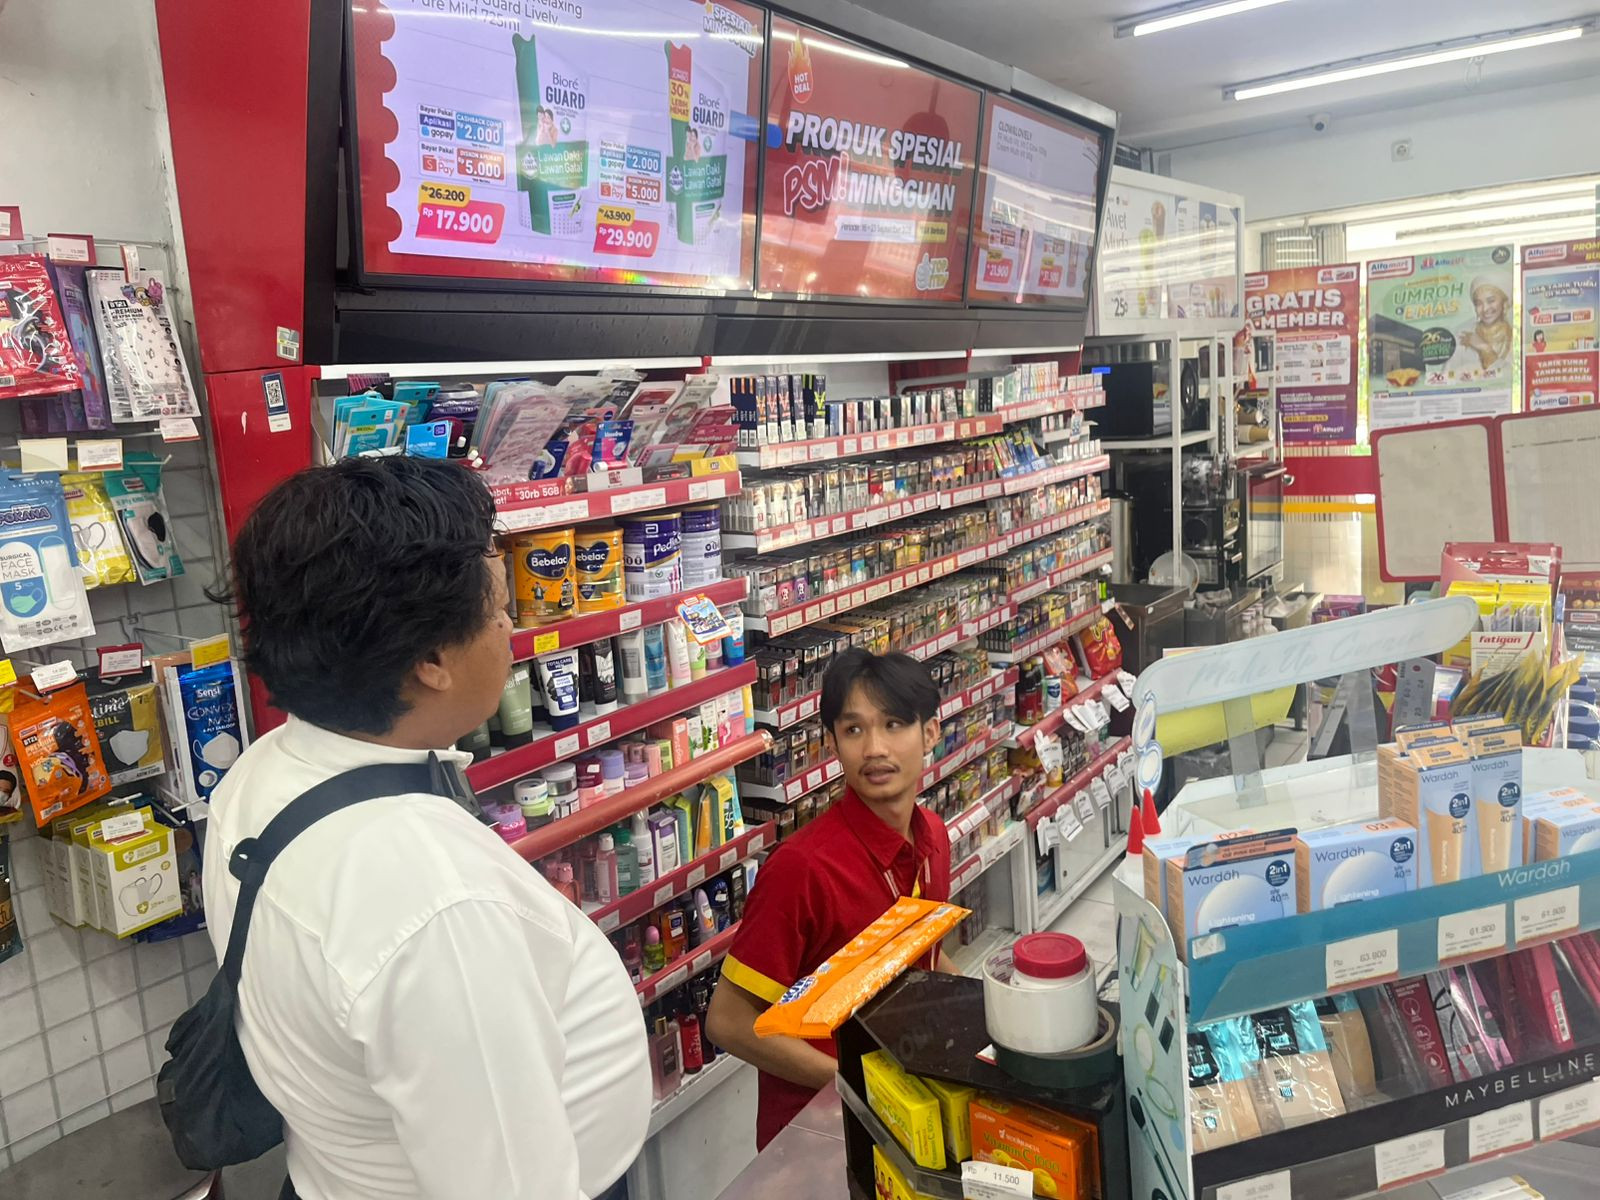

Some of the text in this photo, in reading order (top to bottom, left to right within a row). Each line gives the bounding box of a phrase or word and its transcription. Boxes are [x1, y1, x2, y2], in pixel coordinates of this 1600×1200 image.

[449, 3, 478, 19] Mild
[794, 72, 809, 83] HOT
[794, 82, 811, 94] DEAL
[545, 85, 585, 110] GUARD
[423, 116, 453, 128] Aplikasi
[692, 106, 725, 128] GUARD
[430, 128, 454, 141] gopay
[464, 124, 501, 145] 2.000
[785, 111, 887, 158] PRODUK
[888, 128, 964, 170] SPESIAL
[538, 150, 563, 163] Lawan
[632, 155, 659, 172] 2.000
[438, 162, 455, 177] Pay
[465, 160, 501, 178] 5.000
[539, 161, 583, 175] Lawan Gatal
[428, 187, 465, 202] 26.200
[631, 186, 659, 201] 5.000
[848, 172, 956, 212] MINGGUAN
[423, 207, 494, 234] Rp 17.900
[603, 210, 632, 223] 43.900
[605, 227, 653, 249] 29.900
[1527, 247, 1564, 257] Alfamart
[1371, 259, 1409, 272] Alfamart
[1394, 282, 1465, 305] UMROH
[1246, 288, 1342, 314] GRATIS
[1404, 300, 1460, 321] EMAS
[1260, 310, 1345, 330] MEMBER
[1422, 331, 1441, 345] 26
[541, 486, 560, 498] 5GB
[0, 557, 33, 571] FACE
[531, 556, 568, 567] Bebelac
[576, 552, 606, 562] ebelac
[2, 567, 37, 581] MASK
[15, 582, 22, 590] 5
[1478, 635, 1523, 646] fatigon
[1279, 643, 1316, 676] Up
[1471, 759, 1510, 773] Wardah
[1421, 770, 1460, 784] Wardah
[1501, 785, 1518, 796] 2in1
[1452, 796, 1468, 808] 2in1
[1562, 825, 1597, 839] Wardah
[1393, 841, 1412, 852] 2in1
[1315, 846, 1366, 864] Wardah
[1269, 864, 1288, 875] 2in1
[1394, 871, 1405, 879] 40
[1498, 860, 1571, 888] Wardah
[1188, 869, 1240, 887] Wardah
[1270, 894, 1282, 903] 40
[1444, 1053, 1595, 1109] MAYBELLINE
[1022, 1146, 1032, 1163] C
[1033, 1152, 1061, 1174] 1000
[966, 1165, 1020, 1185] Rp 11.500
